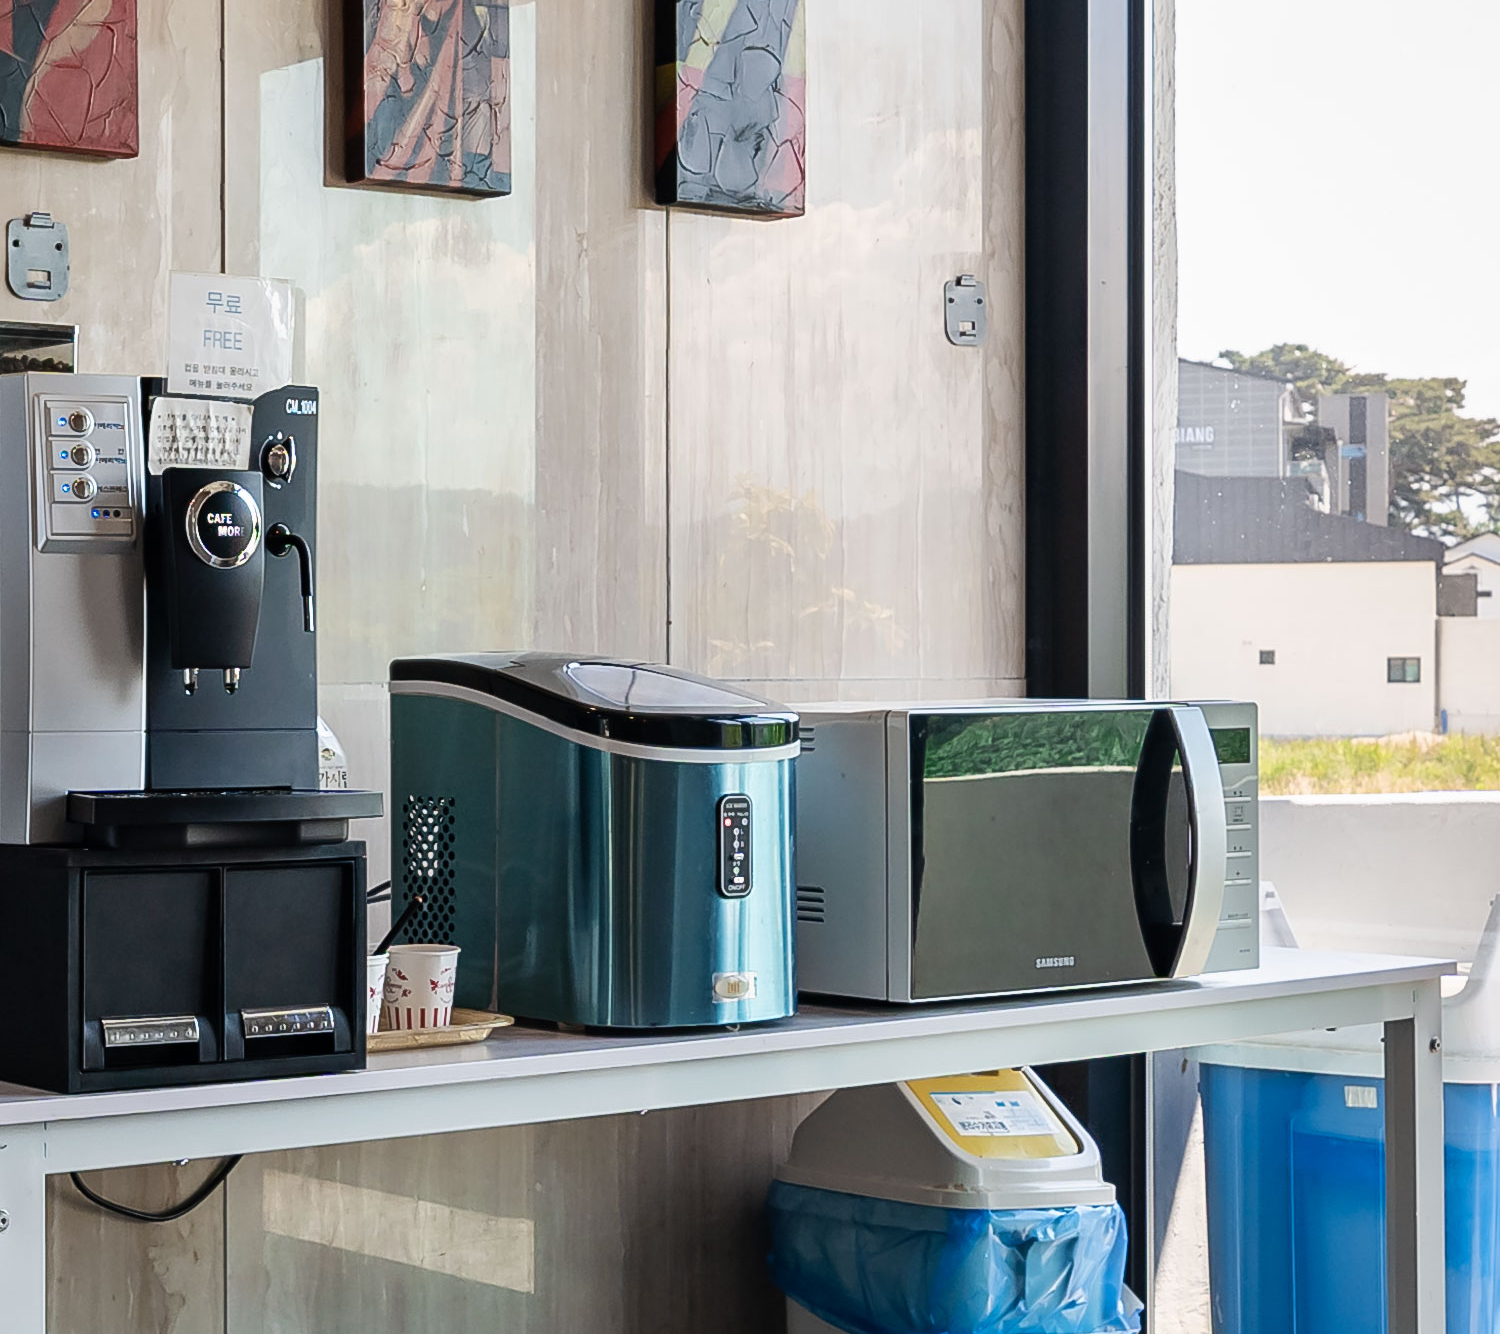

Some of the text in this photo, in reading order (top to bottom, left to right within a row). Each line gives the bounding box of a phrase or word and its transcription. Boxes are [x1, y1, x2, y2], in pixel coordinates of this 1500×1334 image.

[205, 291, 243, 315] 무료
[203, 329, 243, 351] FREE
[207, 512, 233, 525] CAFE
[217, 525, 245, 538] MORE
[1035, 956, 1075, 969] SAMSUNG
